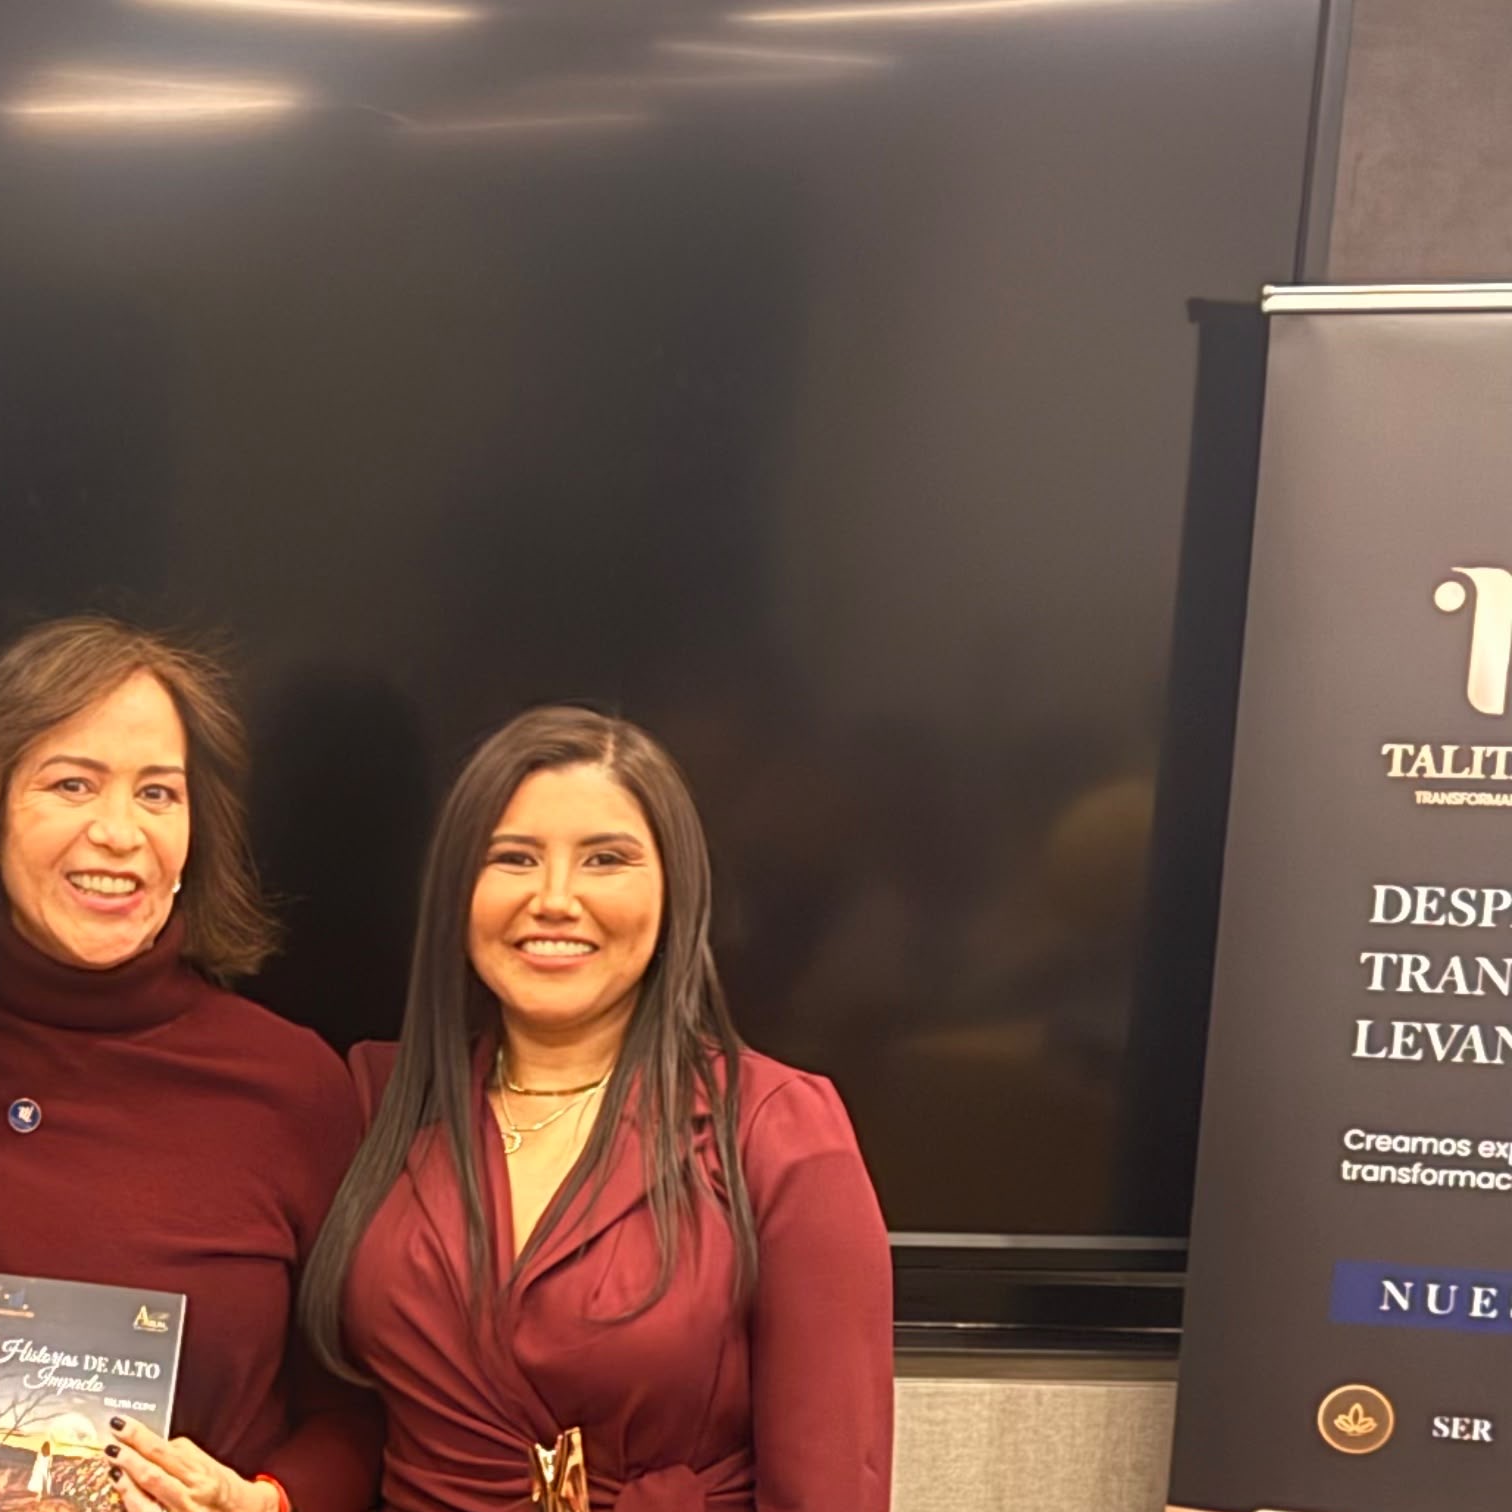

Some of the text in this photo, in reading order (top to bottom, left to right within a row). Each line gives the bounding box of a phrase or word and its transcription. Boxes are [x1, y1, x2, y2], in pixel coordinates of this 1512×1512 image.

[1414, 790, 1512, 806] TRANSFORMA
[1368, 884, 1512, 928] DESP
[1343, 1129, 1512, 1166] Creamos ex
[1341, 1160, 1512, 1190] transformac
[1378, 1280, 1512, 1319] NUE
[83, 1355, 109, 1373] DE
[111, 1359, 161, 1380] ALTO
[1432, 1415, 1493, 1442] SER
